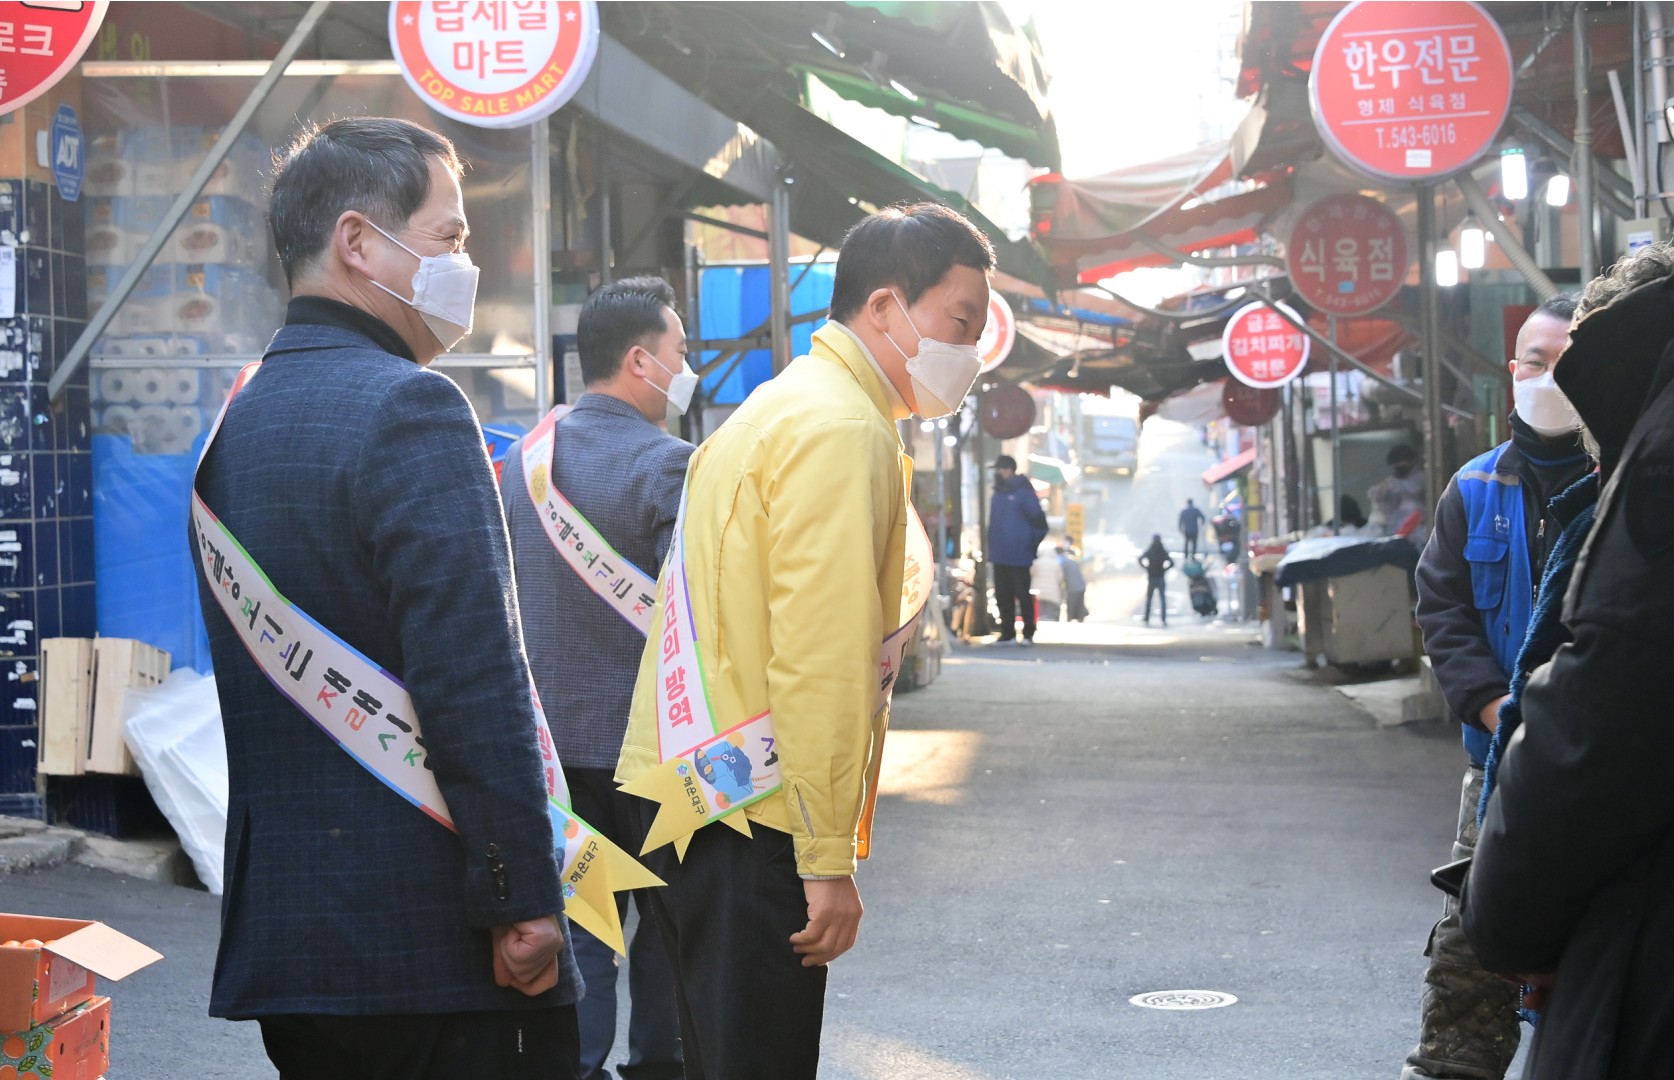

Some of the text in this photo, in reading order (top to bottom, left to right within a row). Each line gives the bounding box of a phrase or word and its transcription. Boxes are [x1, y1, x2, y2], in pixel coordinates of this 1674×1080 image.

[453, 40, 528, 79] 마트
[1342, 35, 1480, 90] 한우전문
[419, 61, 564, 115] TOP SALE MART
[1408, 92, 1466, 112] 식육점
[56, 134, 80, 169] ADT
[1376, 123, 1456, 148] T.543-6016
[1300, 236, 1393, 282] 식육점
[1251, 358, 1286, 379] 전문
[664, 664, 694, 729] 방역
[684, 776, 707, 816] 해운대구
[570, 840, 600, 884] 해운대구
